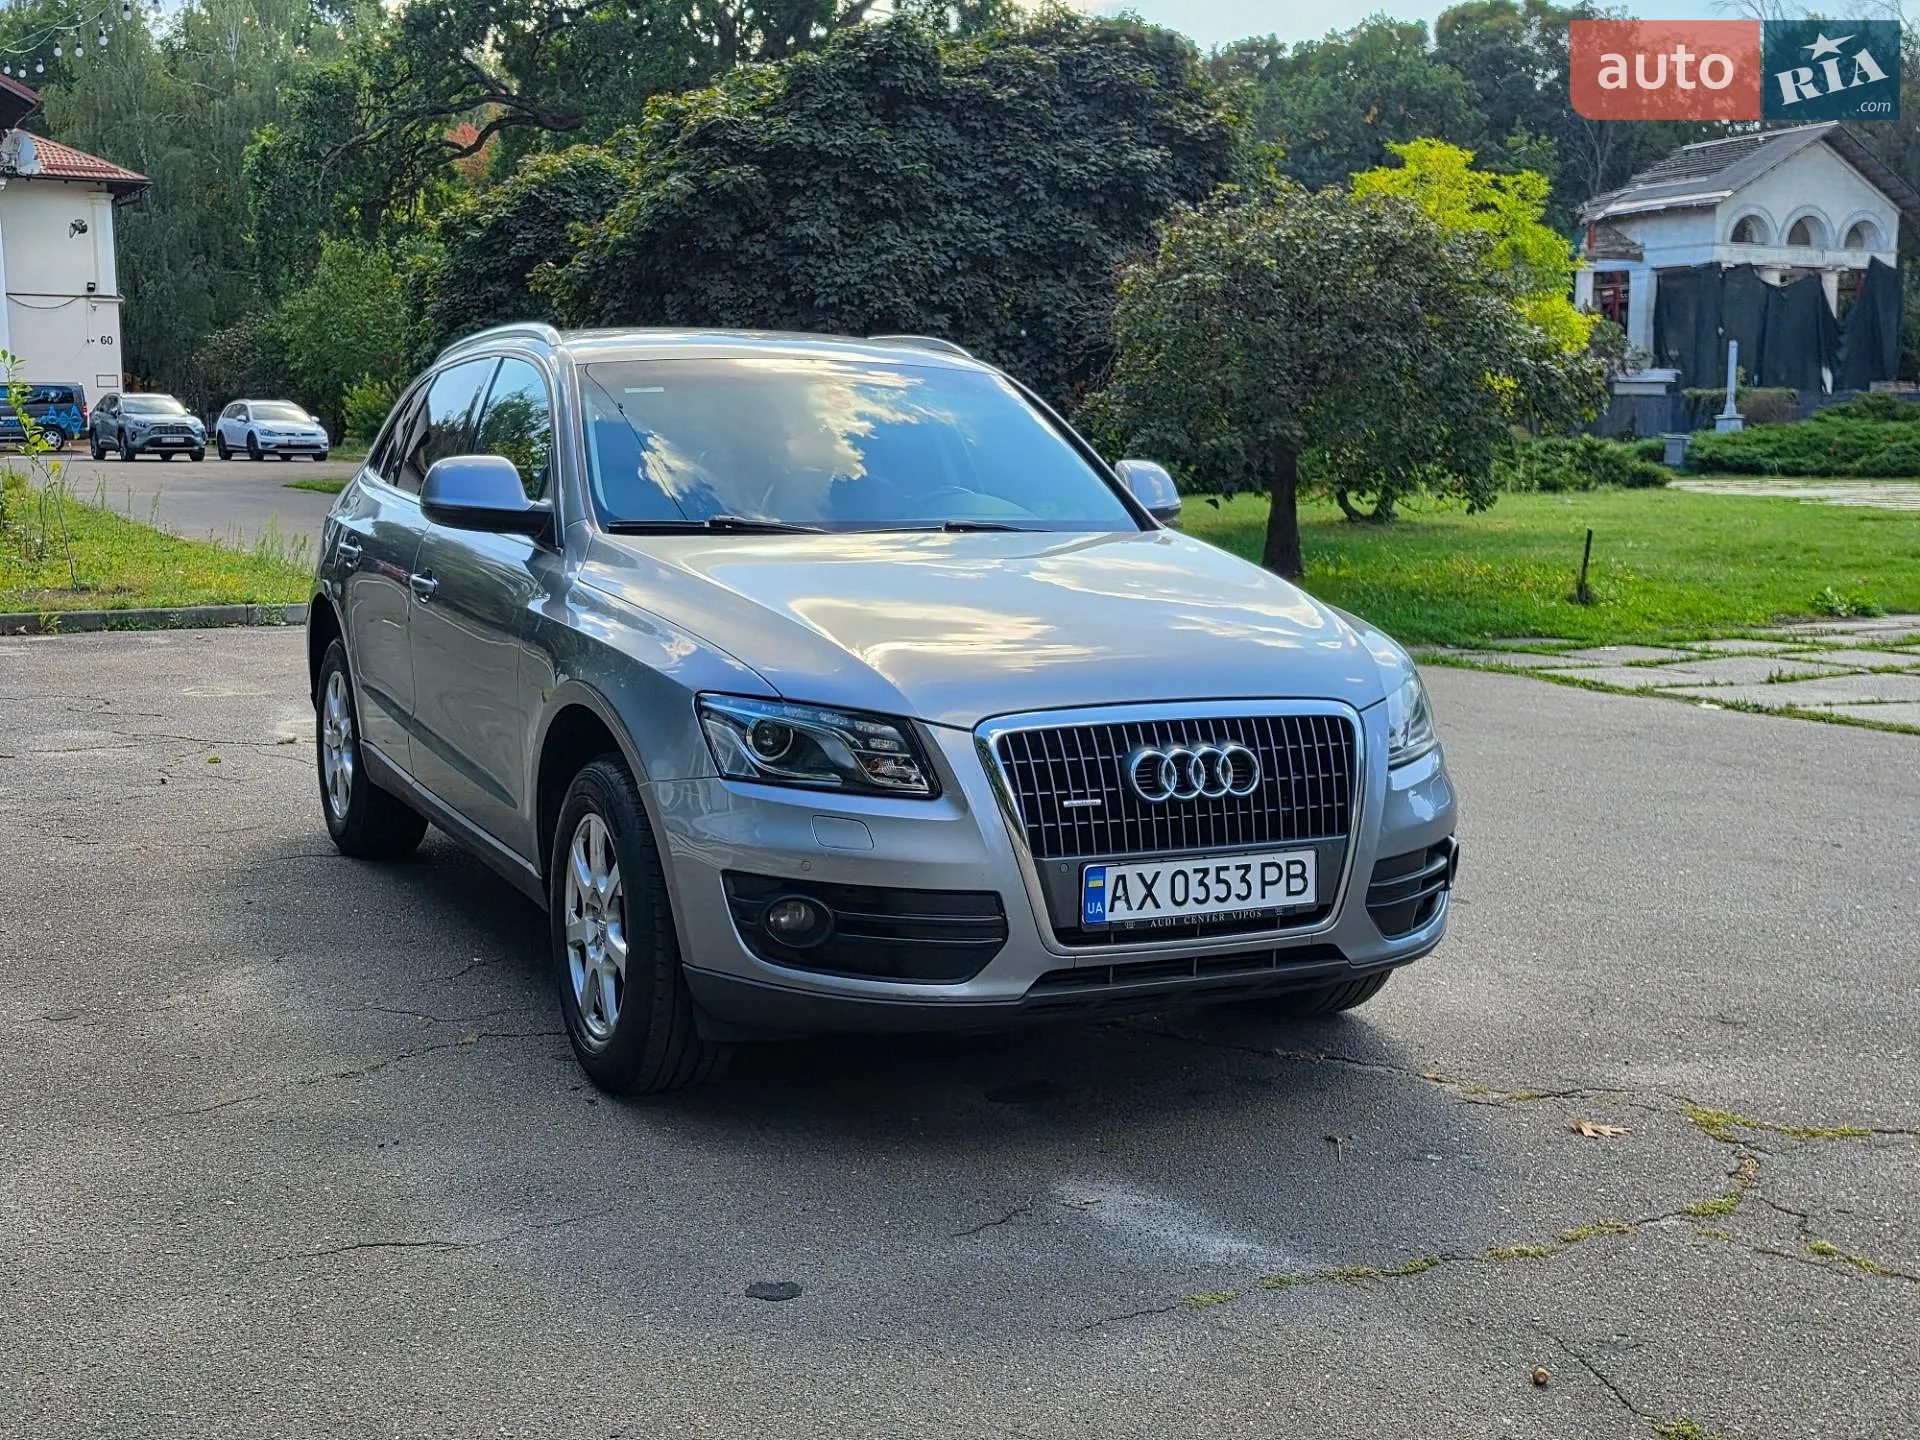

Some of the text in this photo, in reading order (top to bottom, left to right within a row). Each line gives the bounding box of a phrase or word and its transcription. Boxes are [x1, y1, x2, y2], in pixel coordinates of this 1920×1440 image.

[100, 335, 113, 346] 60
[1108, 858, 1309, 913] AX 0353 PB
[1087, 902, 1103, 914] UA
[1150, 910, 1262, 928] AUDI CENTER VIPOS
